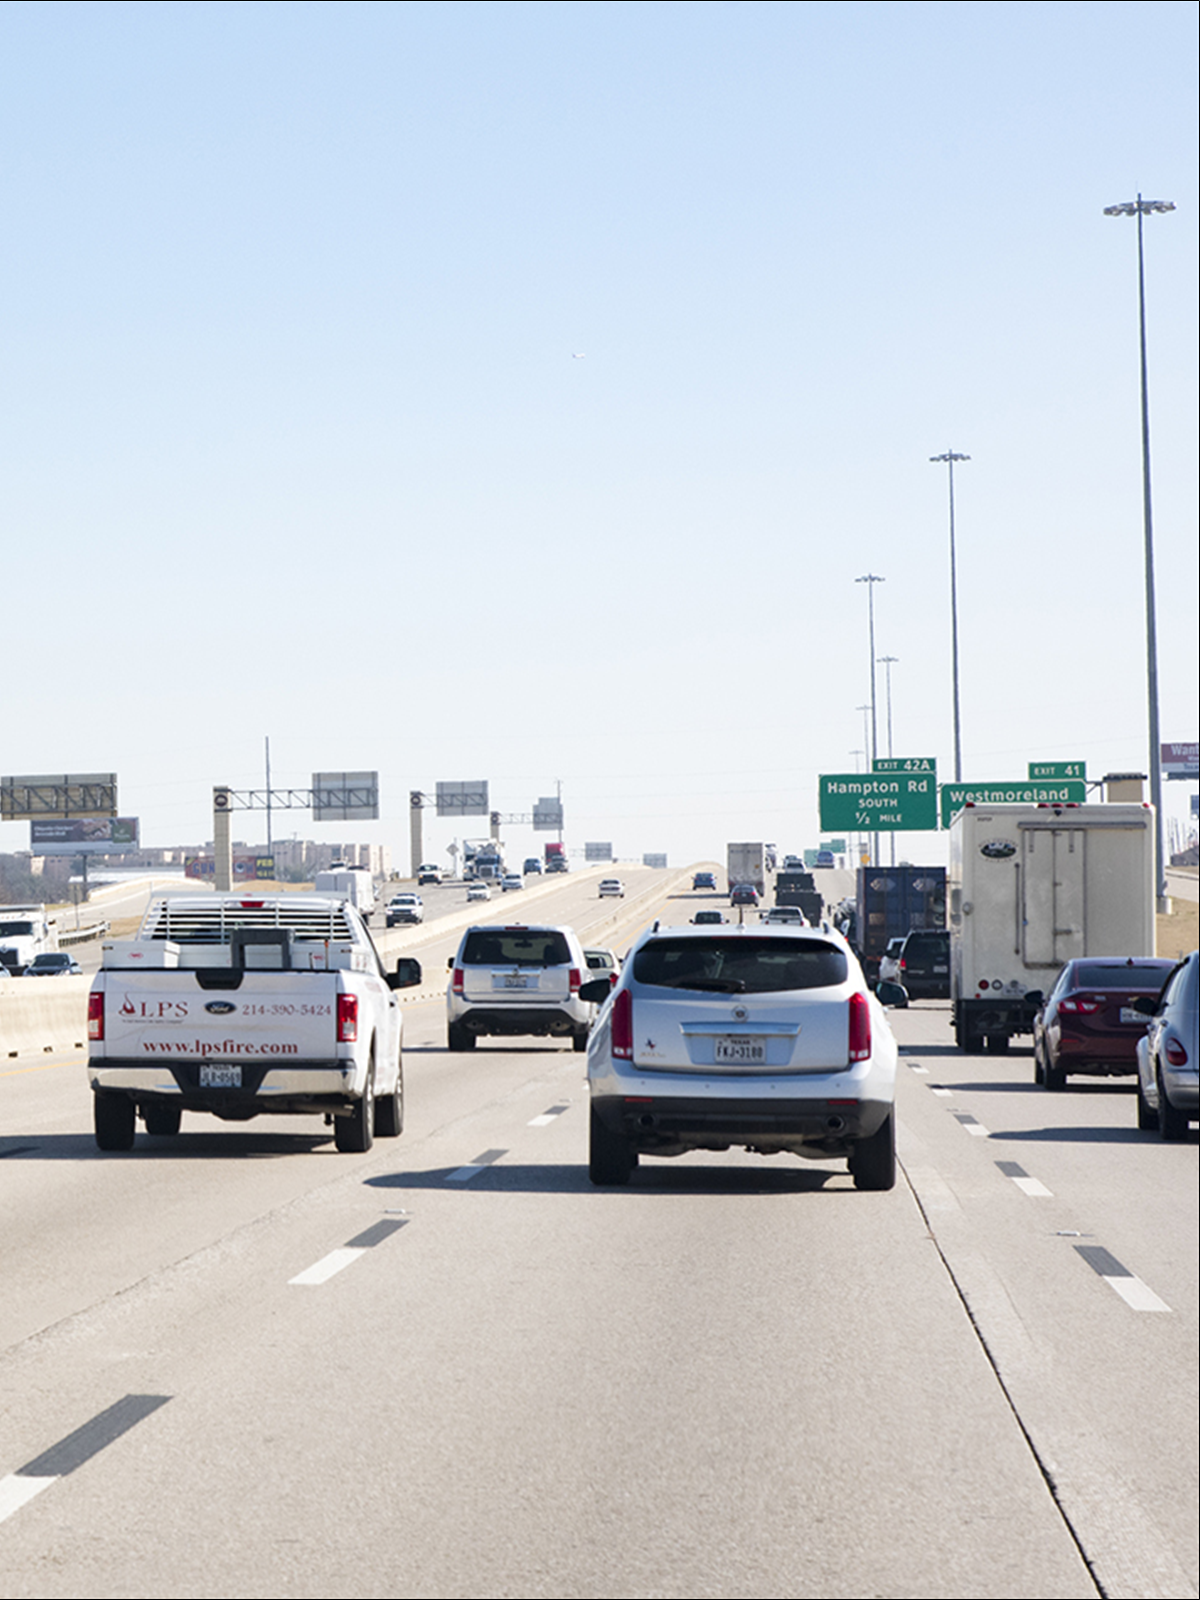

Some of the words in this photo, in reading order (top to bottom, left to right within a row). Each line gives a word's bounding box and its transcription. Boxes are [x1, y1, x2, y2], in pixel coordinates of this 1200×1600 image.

[877, 761, 898, 770] EXIT
[903, 760, 930, 770] 42A
[1034, 767, 1055, 775] EXIT
[1065, 765, 1080, 775] 41
[827, 781, 899, 795] Hampton
[907, 780, 928, 792] Rd
[950, 788, 1069, 802] Westmoreland
[858, 799, 898, 808] SOUTH
[879, 814, 902, 823] MILE
[192, 862, 215, 874] GUN
[141, 1001, 189, 1017] LPS
[242, 1004, 331, 1016] 214-390-5424
[143, 1039, 298, 1056] www.lpsfire.com
